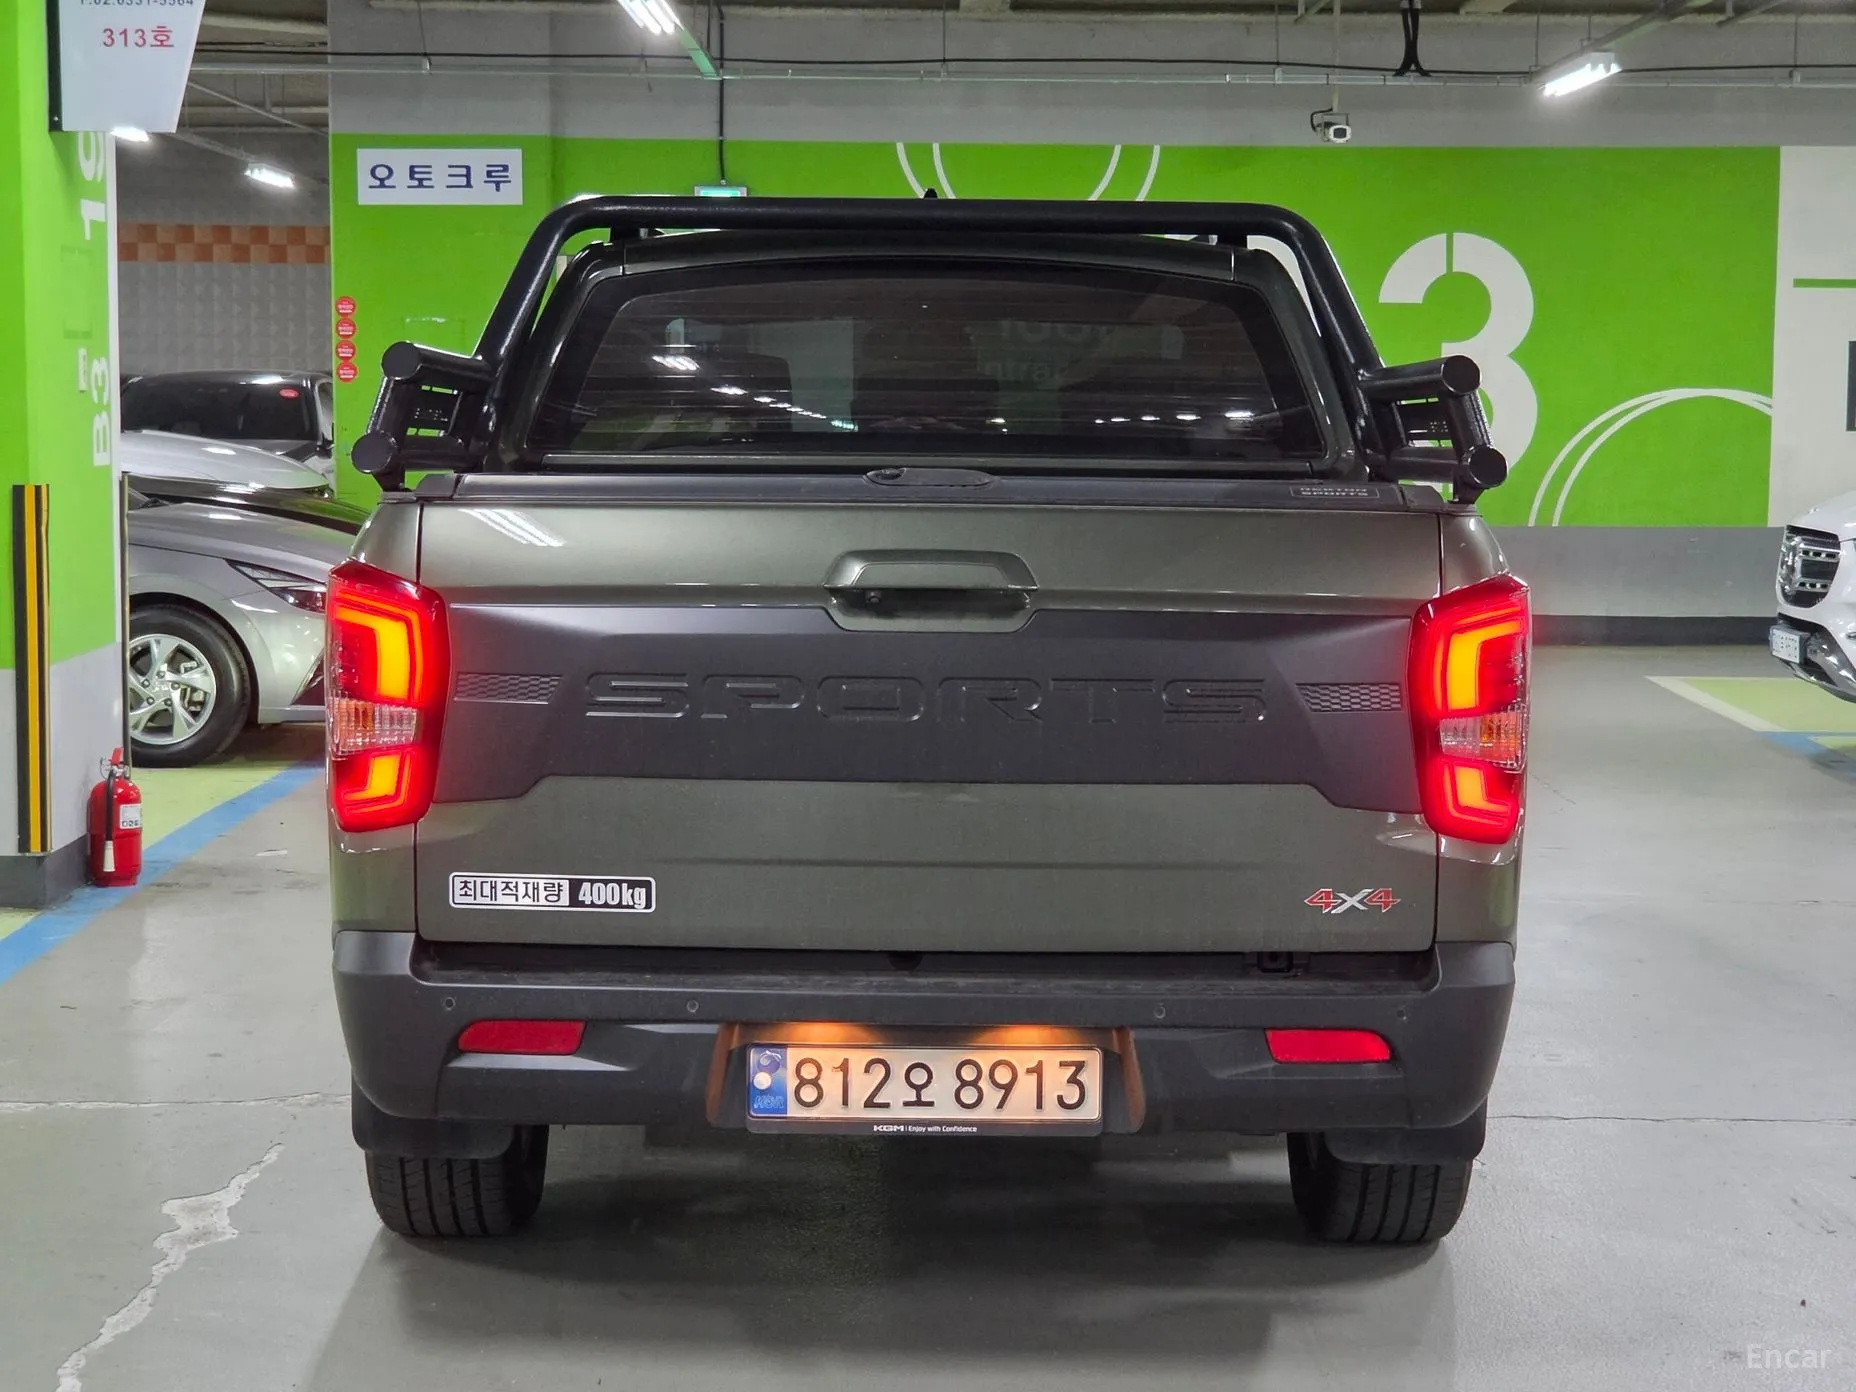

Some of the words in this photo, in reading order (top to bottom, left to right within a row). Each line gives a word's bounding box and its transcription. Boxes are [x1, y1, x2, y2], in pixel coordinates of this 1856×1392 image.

[102, 25, 175, 48] 313호
[368, 163, 512, 193] 오토크루
[91, 356, 111, 466] B3
[584, 672, 1267, 723] SPORTS
[459, 879, 564, 904] 최대적재량
[578, 881, 647, 910] 400kg
[793, 1056, 936, 1110] 812오
[953, 1058, 1088, 1111] 8913
[908, 1125, 926, 1133] Enjoy
